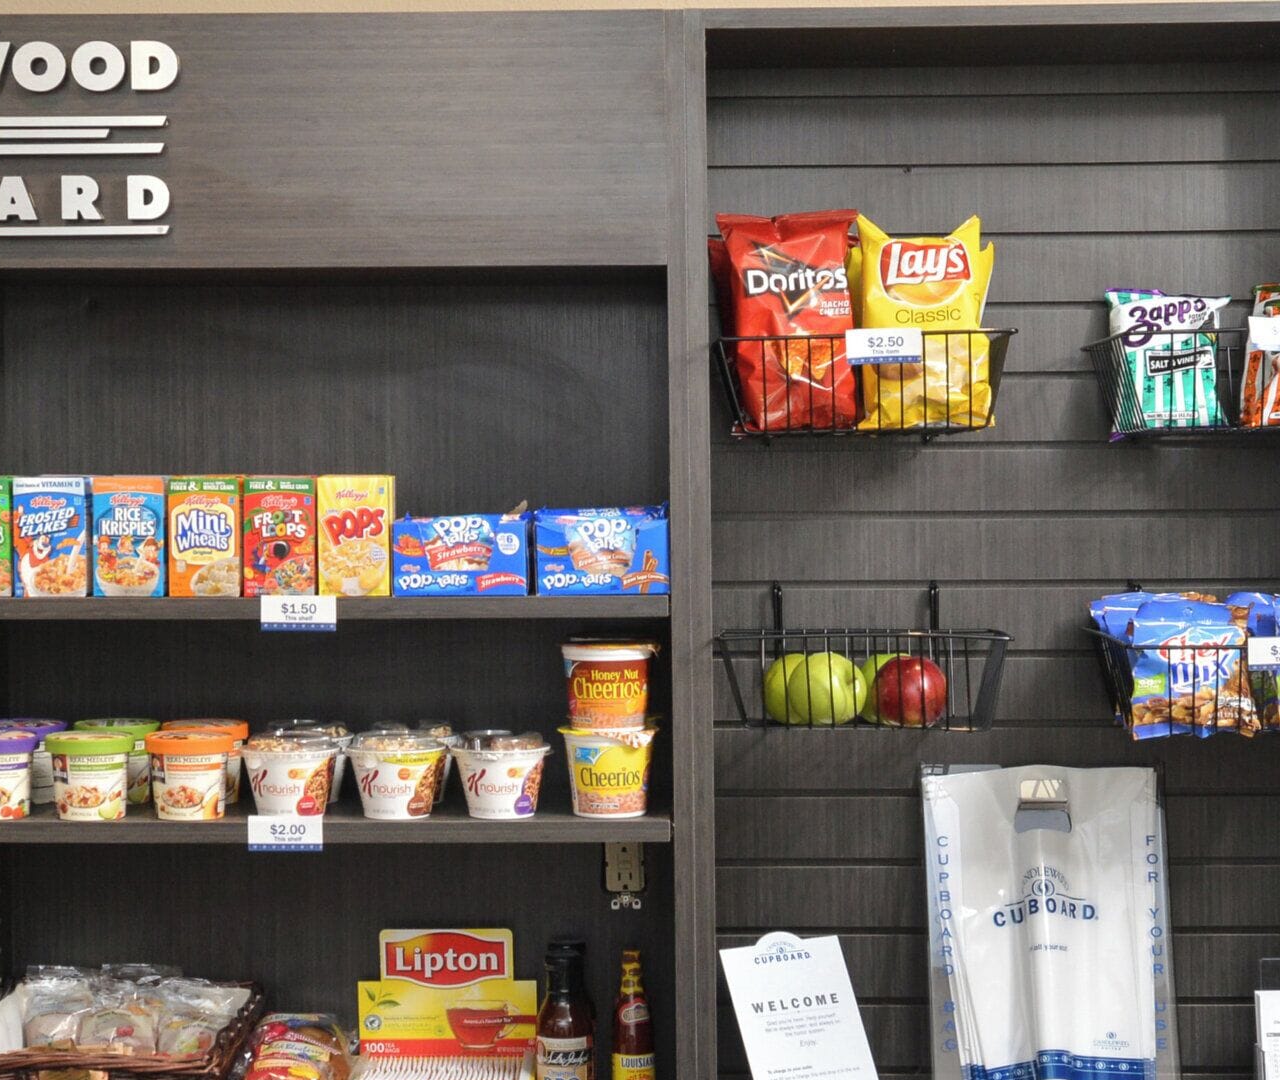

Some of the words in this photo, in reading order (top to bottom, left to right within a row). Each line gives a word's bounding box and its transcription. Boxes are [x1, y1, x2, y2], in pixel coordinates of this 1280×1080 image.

[886, 242, 967, 285] Lay's
[746, 267, 848, 296] Doritos
[895, 307, 961, 325] Classic
[867, 335, 904, 348] $2.50
[1150, 358, 1170, 369] SALT
[19, 508, 74, 526] FROSTED
[114, 507, 141, 520] RICE
[178, 508, 226, 534] Mini
[253, 509, 302, 530] FROOT
[20, 521, 68, 537] FLAKES
[101, 521, 155, 536] KRISPIES
[262, 522, 306, 538] LOOPS
[325, 508, 384, 545] POPS
[176, 531, 229, 552] Wheats
[436, 545, 487, 561] Strawberry
[481, 576, 519, 588] Strawberry
[281, 603, 317, 615] $1.50
[591, 670, 620, 684] Honey
[624, 669, 639, 680] Nut
[573, 677, 641, 700] Cheerios
[580, 766, 640, 787] Cheerios
[262, 783, 300, 795] nourish
[373, 782, 411, 795] nourish
[480, 783, 518, 795] nourish
[270, 824, 306, 836] $2.00
[1145, 835, 1160, 884] FOR
[936, 835, 957, 977] CUPBOARD
[1149, 906, 1165, 977] YOUR
[395, 947, 500, 981] Lipton
[754, 951, 811, 965] CUPBOARD
[751, 993, 840, 1014] WELCOME
[942, 1000, 958, 1052] BAG
[1155, 1001, 1169, 1052] USE
[365, 1043, 385, 1053] 100
[621, 1057, 655, 1068] LOUISIAN
